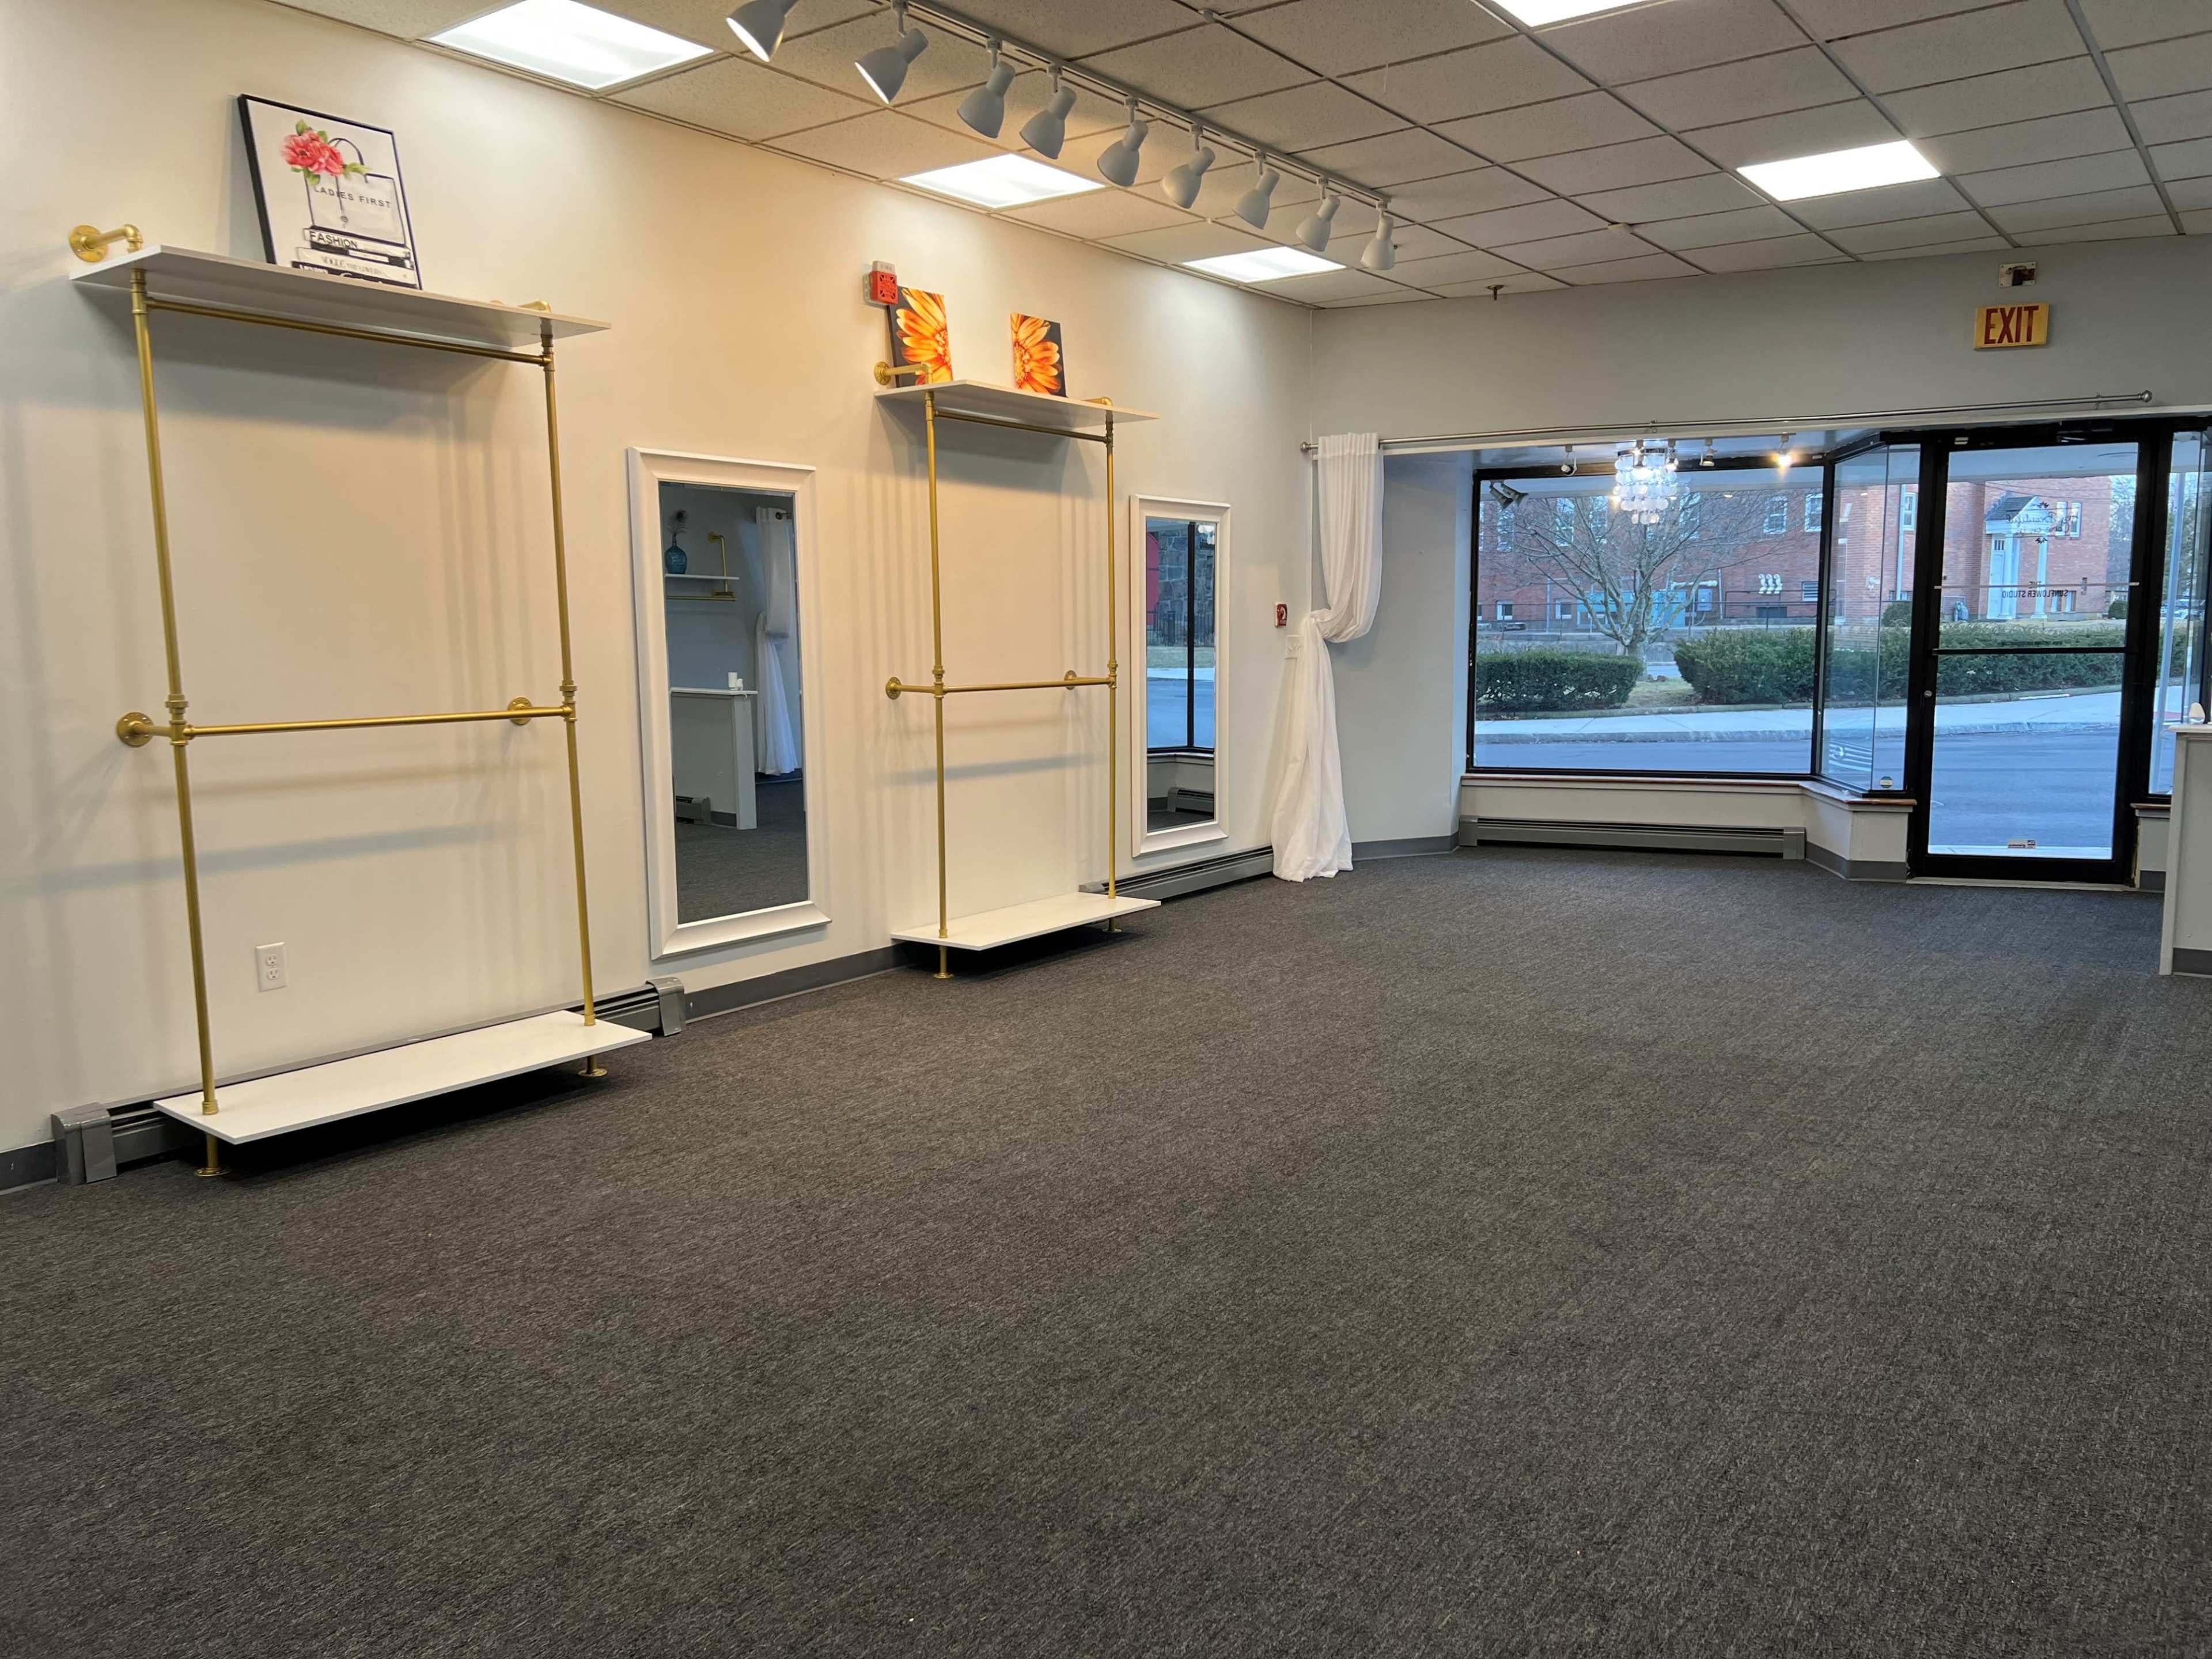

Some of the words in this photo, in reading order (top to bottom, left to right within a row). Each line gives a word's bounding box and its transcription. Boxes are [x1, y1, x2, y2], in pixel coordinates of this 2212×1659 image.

[314, 186, 354, 200] LADIES
[359, 196, 391, 208] FIRST
[309, 231, 358, 249] FASHION
[1984, 305, 2039, 344] EXIT
